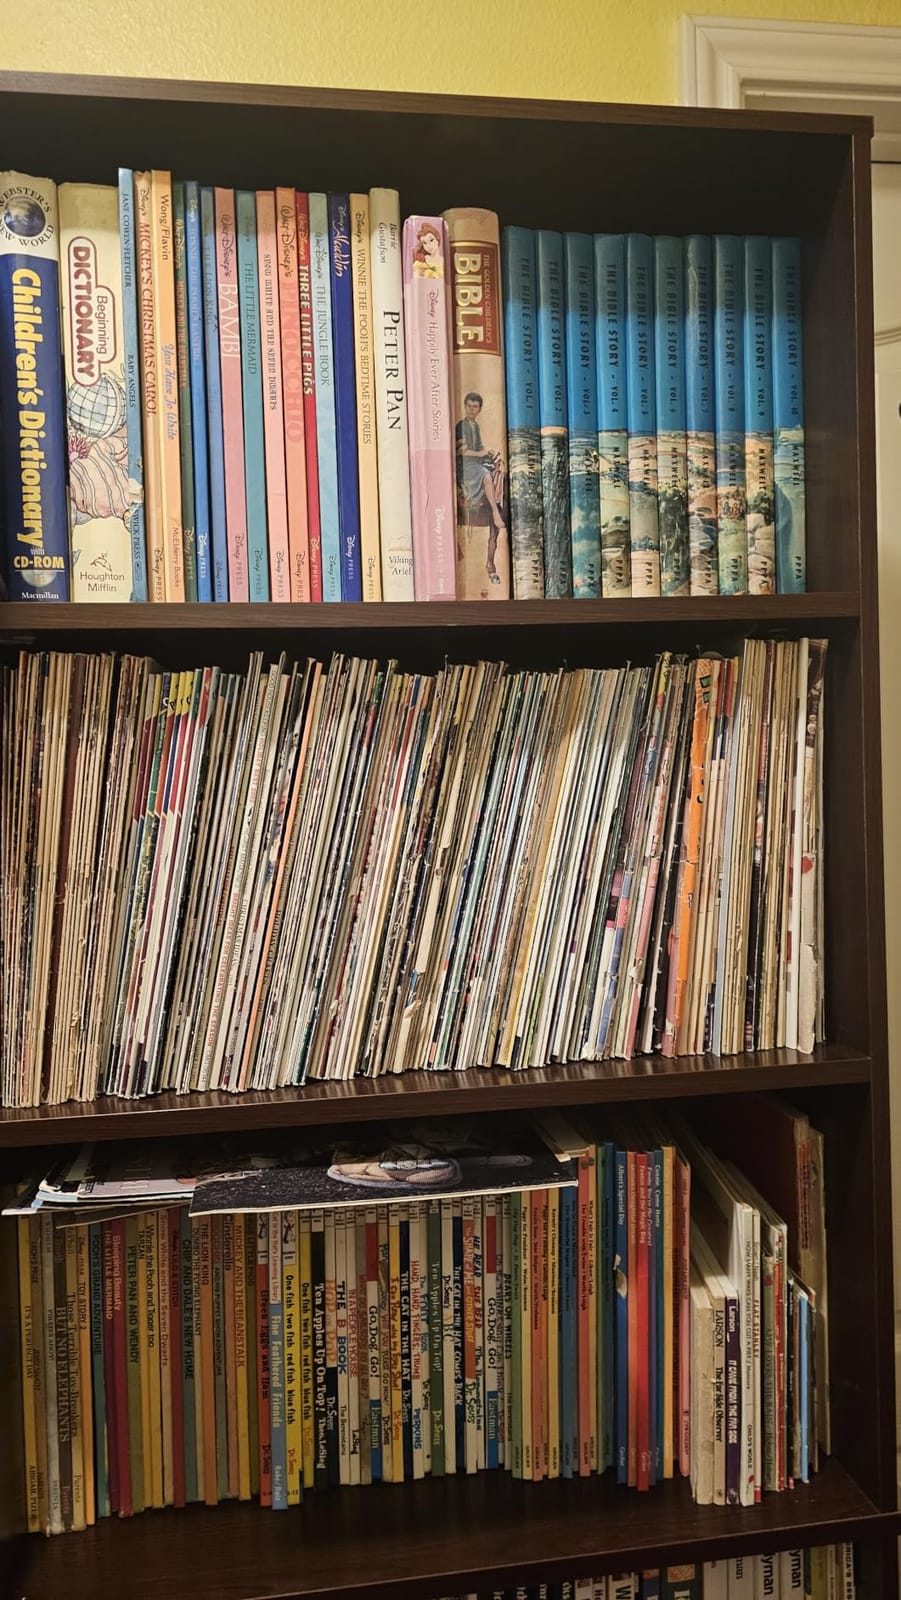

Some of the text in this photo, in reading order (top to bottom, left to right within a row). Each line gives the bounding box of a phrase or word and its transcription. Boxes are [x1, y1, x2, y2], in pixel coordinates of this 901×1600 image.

[18, 224, 55, 247] WORLD
[160, 195, 170, 260] Wong/Flavin
[378, 222, 386, 264] Gustafson
[123, 215, 133, 287] COWEN-FLETCHER
[73, 247, 94, 378] DICTIONARY
[454, 252, 483, 345] BIBLE
[607, 264, 618, 367] THE STORY
[95, 296, 108, 354] Beginning
[140, 223, 157, 417] MICKEY'S CHRISTMAS CAROL
[219, 283, 240, 358] BAMBI
[245, 262, 257, 374] THE LITTLE MERMAID
[299, 264, 314, 395] THREE LITTLE PIGS
[316, 286, 330, 386] THE JUNGLE BOOK
[484, 301, 492, 344] CHILDREN'S
[281, 281, 303, 440] PINOCCHIO
[357, 248, 372, 444] WINNIE THE POOH'S BEDTIME STORIES
[522, 326, 532, 362] STORY
[552, 329, 561, 367] STORY
[580, 332, 590, 369] STORY
[638, 332, 648, 369] STORY
[667, 332, 677, 368] STORY
[699, 332, 709, 368] STORY
[726, 330, 735, 366] STORY
[755, 334, 765, 370] STORY
[787, 331, 797, 367] STORY
[383, 311, 403, 430] PETER PAN
[427, 322, 442, 441] Happily Ever After Stories
[12, 268, 47, 548] Children's Dictionary
[14, 556, 65, 568] CD-ROM
[172, 527, 182, 587] McElderry Books
[389, 555, 413, 565] Viking
[392, 567, 412, 575] Ariel
[22, 592, 59, 600] Macmillan
[80, 572, 124, 582] Houghton
[88, 583, 117, 592] Mifflin
[146, 1225, 154, 1253] Winnie
[183, 1240, 191, 1260] CHIP
[224, 1214, 232, 1271] Cinderella
[93, 1270, 101, 1301] GRAND
[112, 1235, 122, 1311] Sleeping Beauty
[147, 1270, 155, 1289] Pooh
[286, 1275, 294, 1291] One
[128, 1246, 139, 1363] PETER PAN AND WENDY
[184, 1289, 192, 1322] DALE'S
[286, 1293, 294, 1308] fish
[729, 1306, 737, 1332] Larson
[94, 1303, 102, 1356] ADVENTURE
[237, 1310, 245, 1367] BEANSTALK
[286, 1314, 294, 1329] two
[286, 1332, 295, 1348] fish
[326, 1281, 336, 1362] HOP POP
[338, 1320, 345, 1328] B
[402, 1321, 408, 1332] IN
[66, 1292, 79, 1437] Those Terrible Toy-Breakers
[185, 1351, 193, 1380] HOME
[314, 1284, 325, 1412] Ten Apples Up On Top!
[338, 1336, 347, 1374] BOOK
[56, 1307, 70, 1442] BUT NO ELEPHANTS
[272, 1316, 282, 1428] Fine Friends
[287, 1370, 295, 1384] fish
[402, 1359, 410, 1381] HAT
[488, 1319, 497, 1440] Dog. Go! Eastman
[287, 1390, 295, 1406] blue
[370, 1356, 380, 1449] Go! Eastman
[729, 1405, 737, 1416] THE
